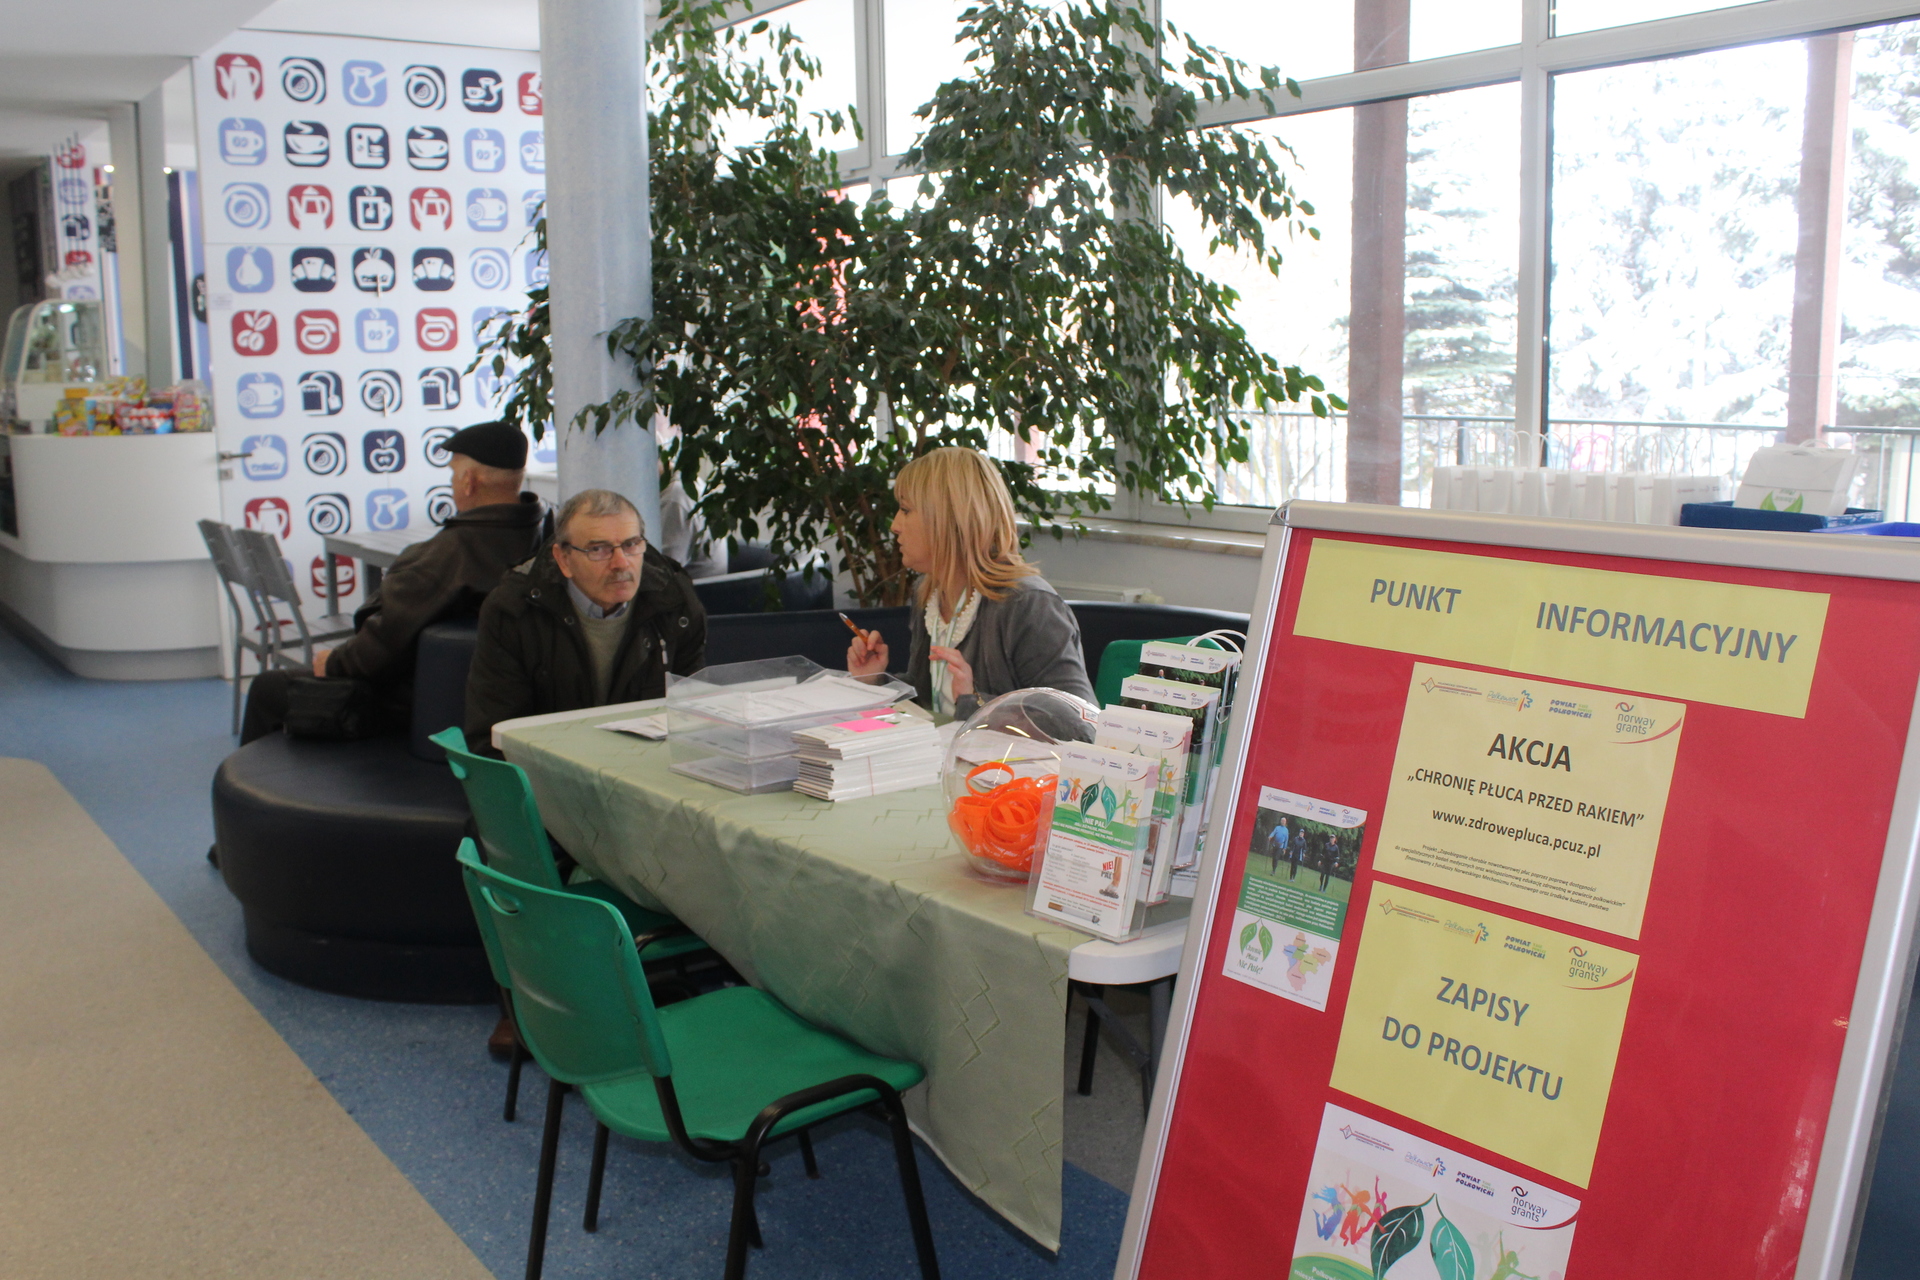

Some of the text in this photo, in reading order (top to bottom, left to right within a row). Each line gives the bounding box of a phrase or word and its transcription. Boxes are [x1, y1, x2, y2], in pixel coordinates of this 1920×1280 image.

[1370, 578, 1797, 663] PUNKT INFORMACYJNY
[1548, 706, 1591, 718] POLKOWICKI
[1549, 699, 1576, 708] POWIAT
[1615, 722, 1646, 734] grants
[1617, 713, 1655, 728] norway
[1488, 733, 1570, 772] AKCJA
[1407, 768, 1644, 827] „CHRONIĘ PŁUCA PRZED RAKIEM”
[1432, 809, 1600, 858] www.zdrowepluca.pcuz.pl
[1422, 844, 1437, 852] Projekt
[1505, 935, 1531, 946] POWIAT
[1503, 942, 1545, 959] POLKOWICKI
[1568, 966, 1599, 982] grants
[1570, 957, 1607, 976] norway
[1436, 976, 1529, 1026] ZAPISY
[1382, 1016, 1563, 1100] DO PROJEKTU
[1456, 1170, 1480, 1183] POWIAT
[1455, 1177, 1494, 1196] POLKOWICKI
[1510, 1205, 1539, 1222] grants
[1512, 1196, 1547, 1217] norway
